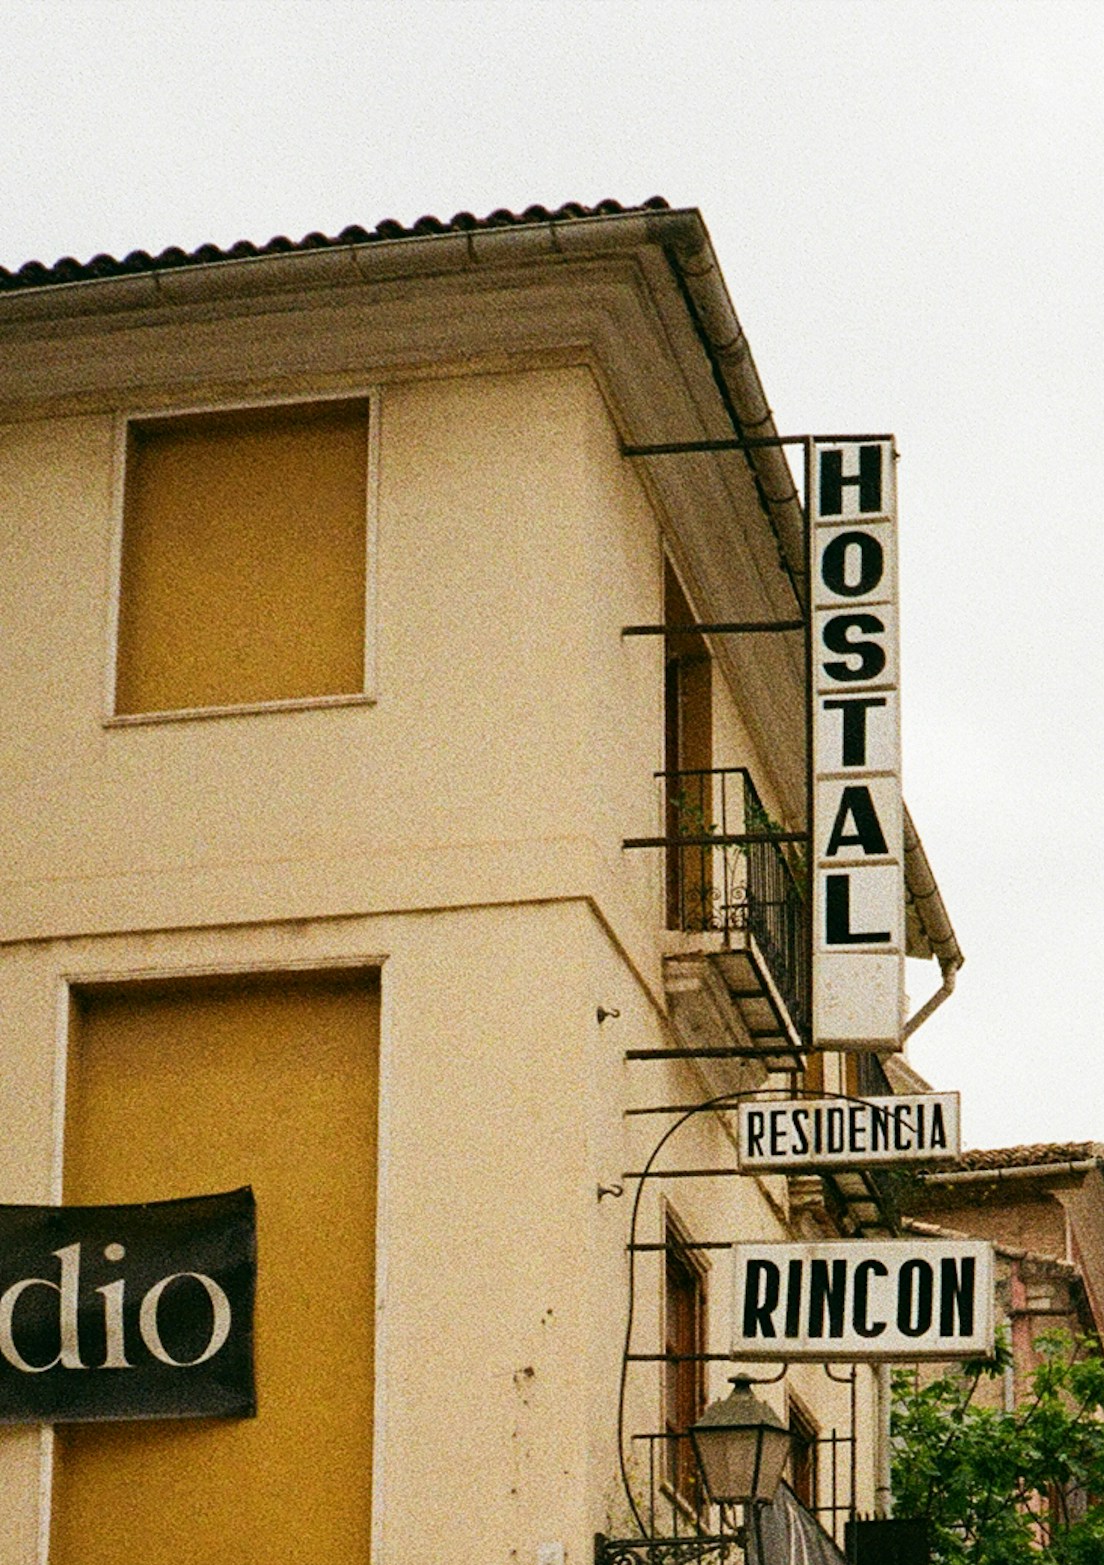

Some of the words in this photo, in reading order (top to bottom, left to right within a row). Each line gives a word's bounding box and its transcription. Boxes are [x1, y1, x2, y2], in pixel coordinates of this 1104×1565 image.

[819, 445, 891, 945] HOSTAL
[747, 1102, 947, 1158] RESIDENCIA
[0, 1242, 232, 1373] dio
[742, 1256, 976, 1338] RINCON
